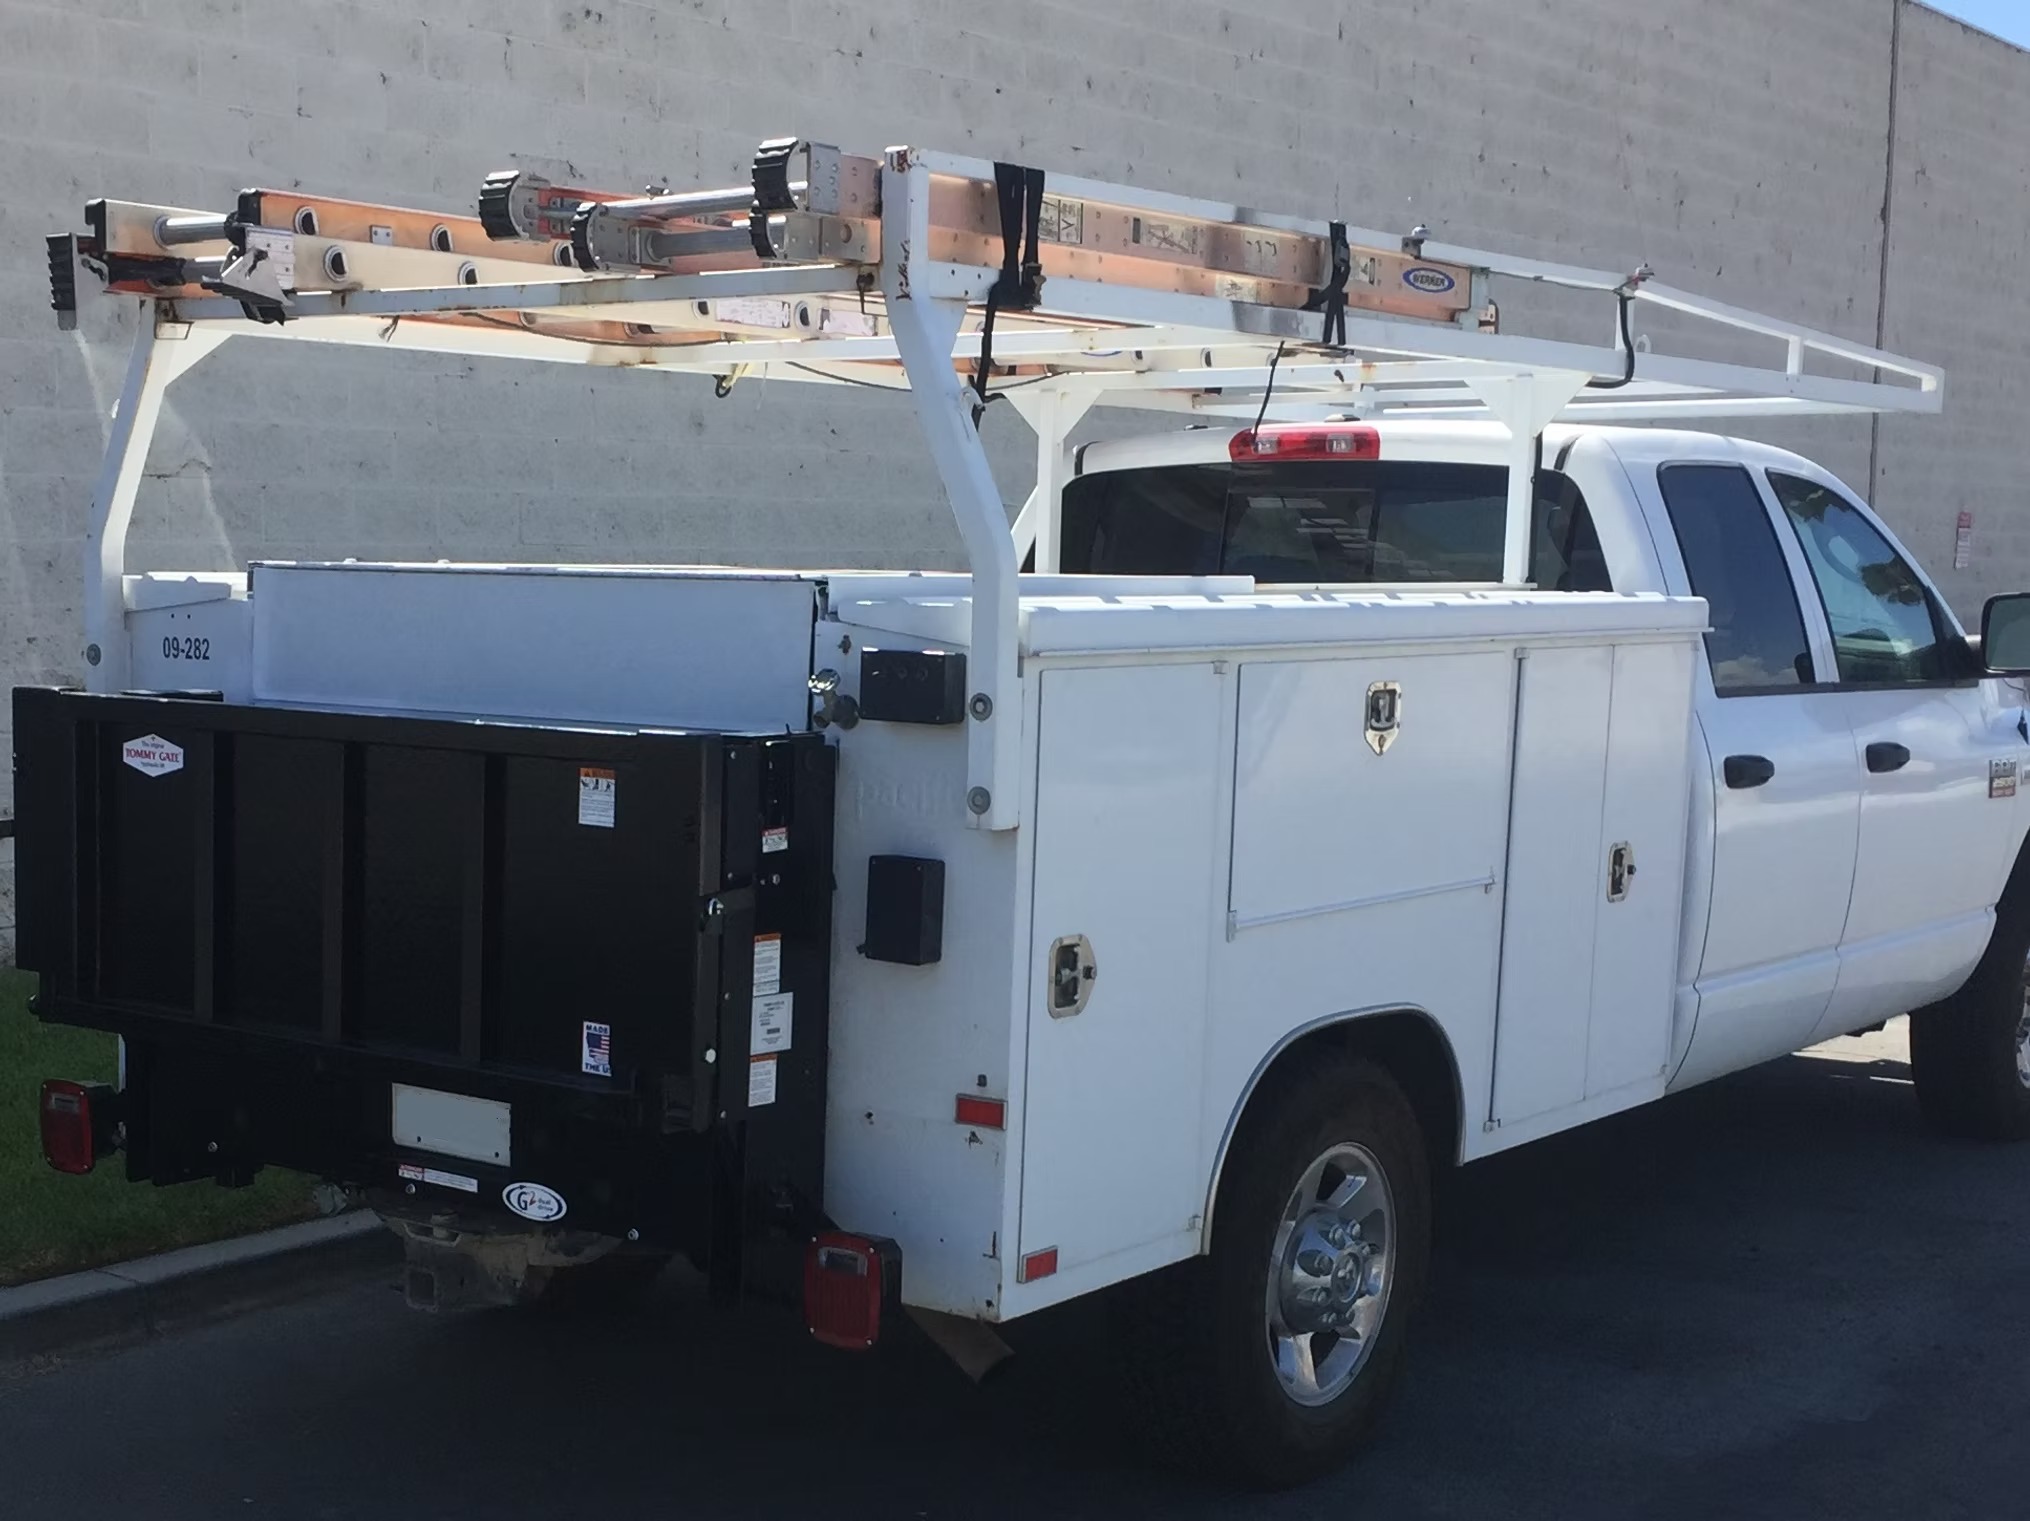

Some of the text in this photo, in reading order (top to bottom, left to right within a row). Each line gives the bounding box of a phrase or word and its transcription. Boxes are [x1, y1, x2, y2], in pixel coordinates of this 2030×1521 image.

[163, 636, 210, 660] 09-282
[125, 748, 180, 763] TOMMY GATE
[586, 1024, 609, 1034] MADE
[585, 1062, 601, 1072] THE
